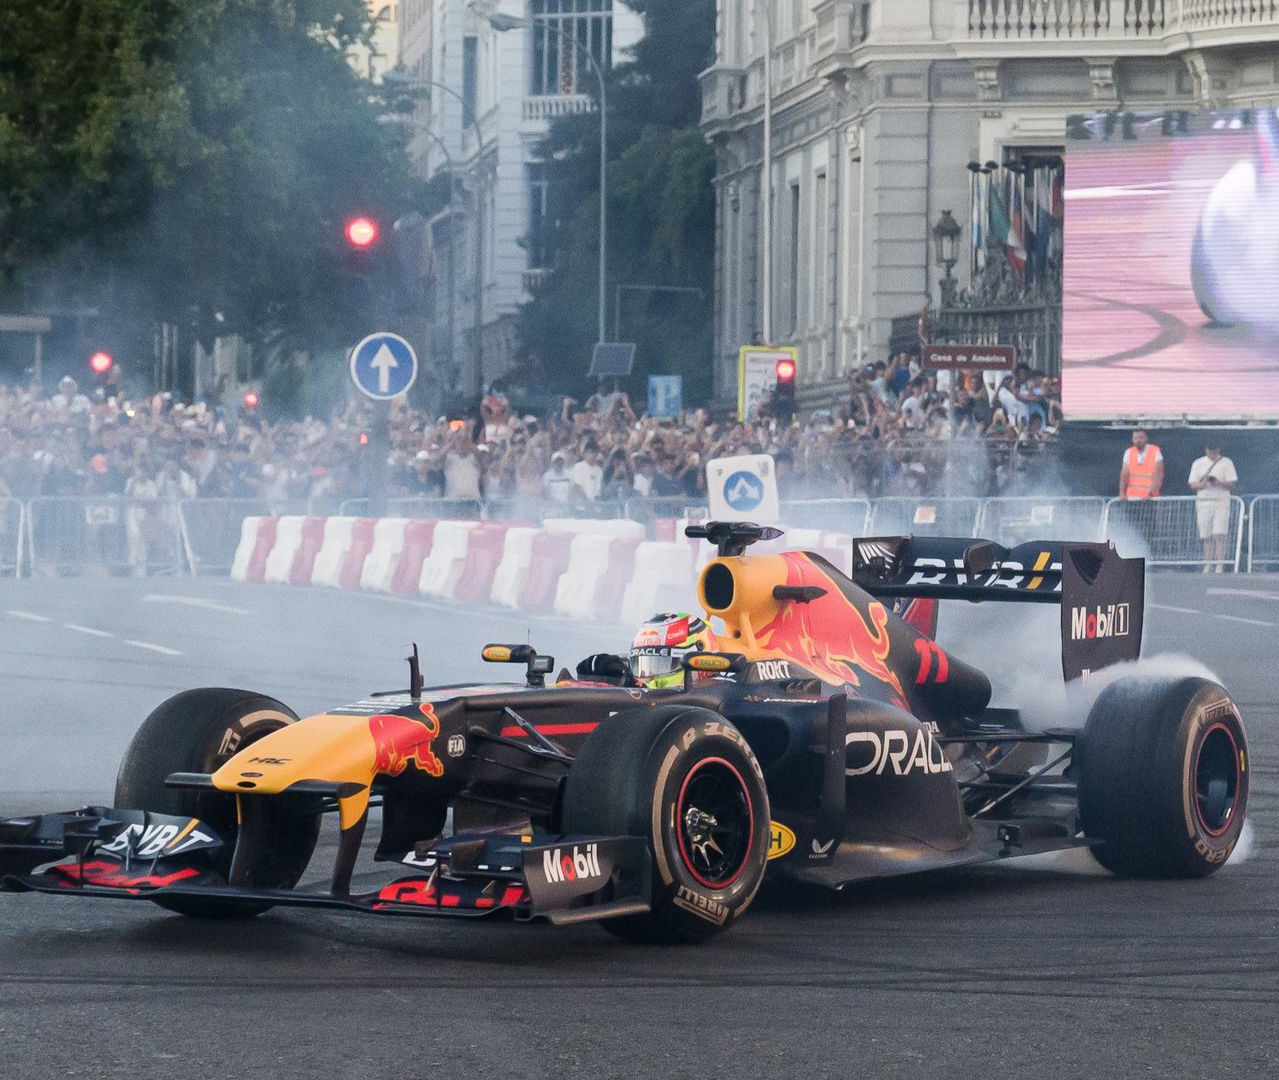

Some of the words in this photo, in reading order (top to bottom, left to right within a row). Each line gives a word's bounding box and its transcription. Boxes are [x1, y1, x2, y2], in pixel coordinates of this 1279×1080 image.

[930, 353, 952, 362] Casa
[956, 354, 967, 362] de
[1072, 604, 1115, 639] Mobil
[757, 661, 791, 680] ROKT
[915, 638, 949, 684] 11
[449, 739, 464, 751] FIA
[543, 844, 601, 883] Mobil
